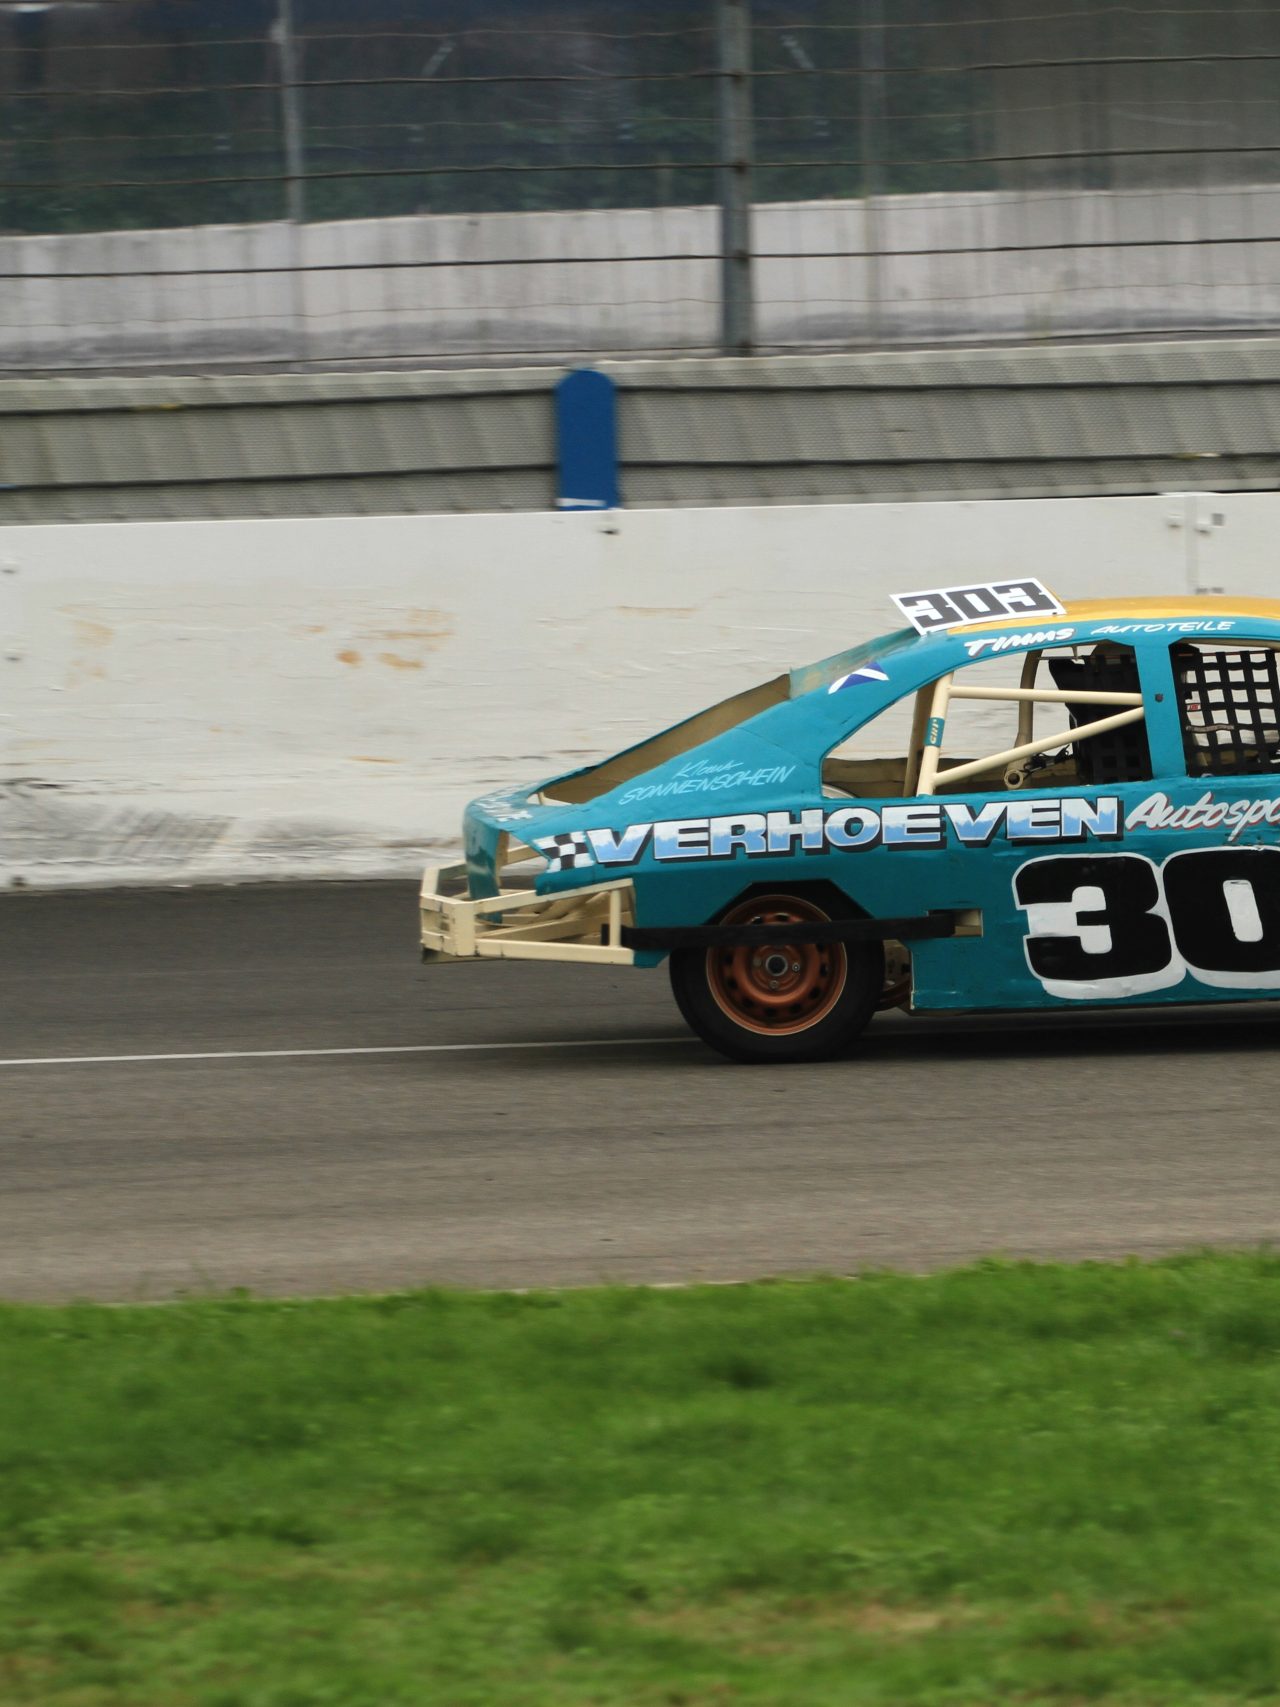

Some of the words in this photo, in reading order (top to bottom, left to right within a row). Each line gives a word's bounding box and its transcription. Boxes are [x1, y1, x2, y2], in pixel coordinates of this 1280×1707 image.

[898, 580, 1058, 630] 303
[964, 627, 1077, 658] TIMMS
[1090, 620, 1236, 636] AUTOTEILE
[618, 765, 797, 806] SONNENSCHEIN
[672, 759, 744, 779] Klaus
[586, 796, 1123, 867] VERHOEVEN
